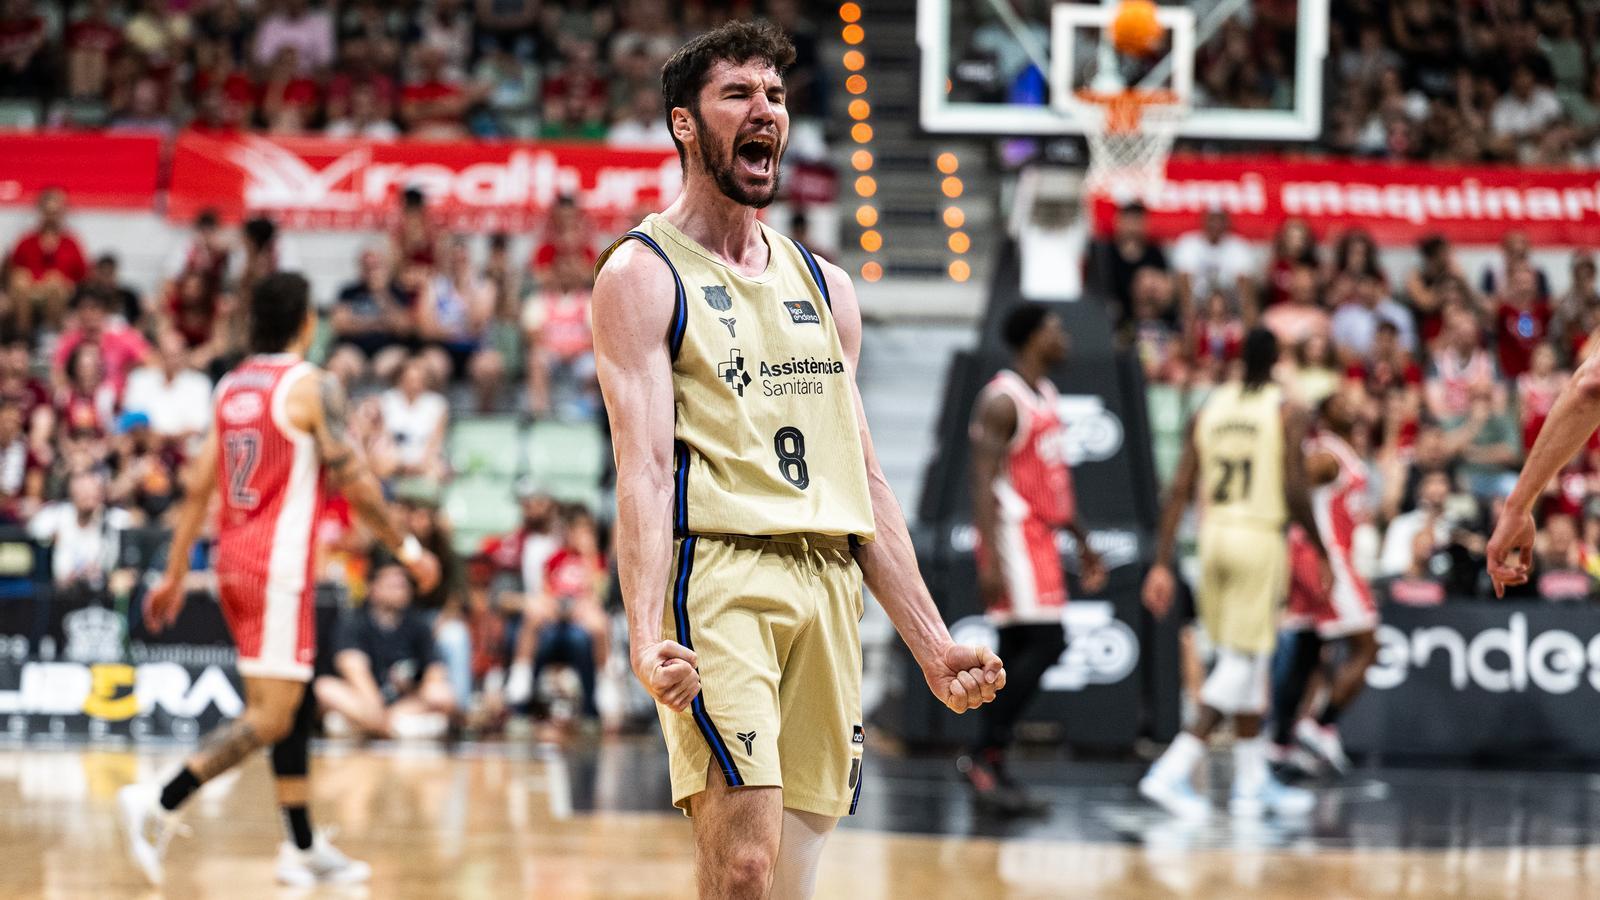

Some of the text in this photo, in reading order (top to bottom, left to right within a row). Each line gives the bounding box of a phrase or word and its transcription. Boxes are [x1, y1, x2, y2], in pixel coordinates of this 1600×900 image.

[1281, 178, 1600, 224] maquinar
[760, 357, 845, 377] Assistència
[762, 376, 824, 397] Sanitària
[222, 428, 264, 510] 12
[773, 426, 810, 490] 8
[1213, 456, 1252, 505] 21
[1365, 611, 1600, 694] ende
